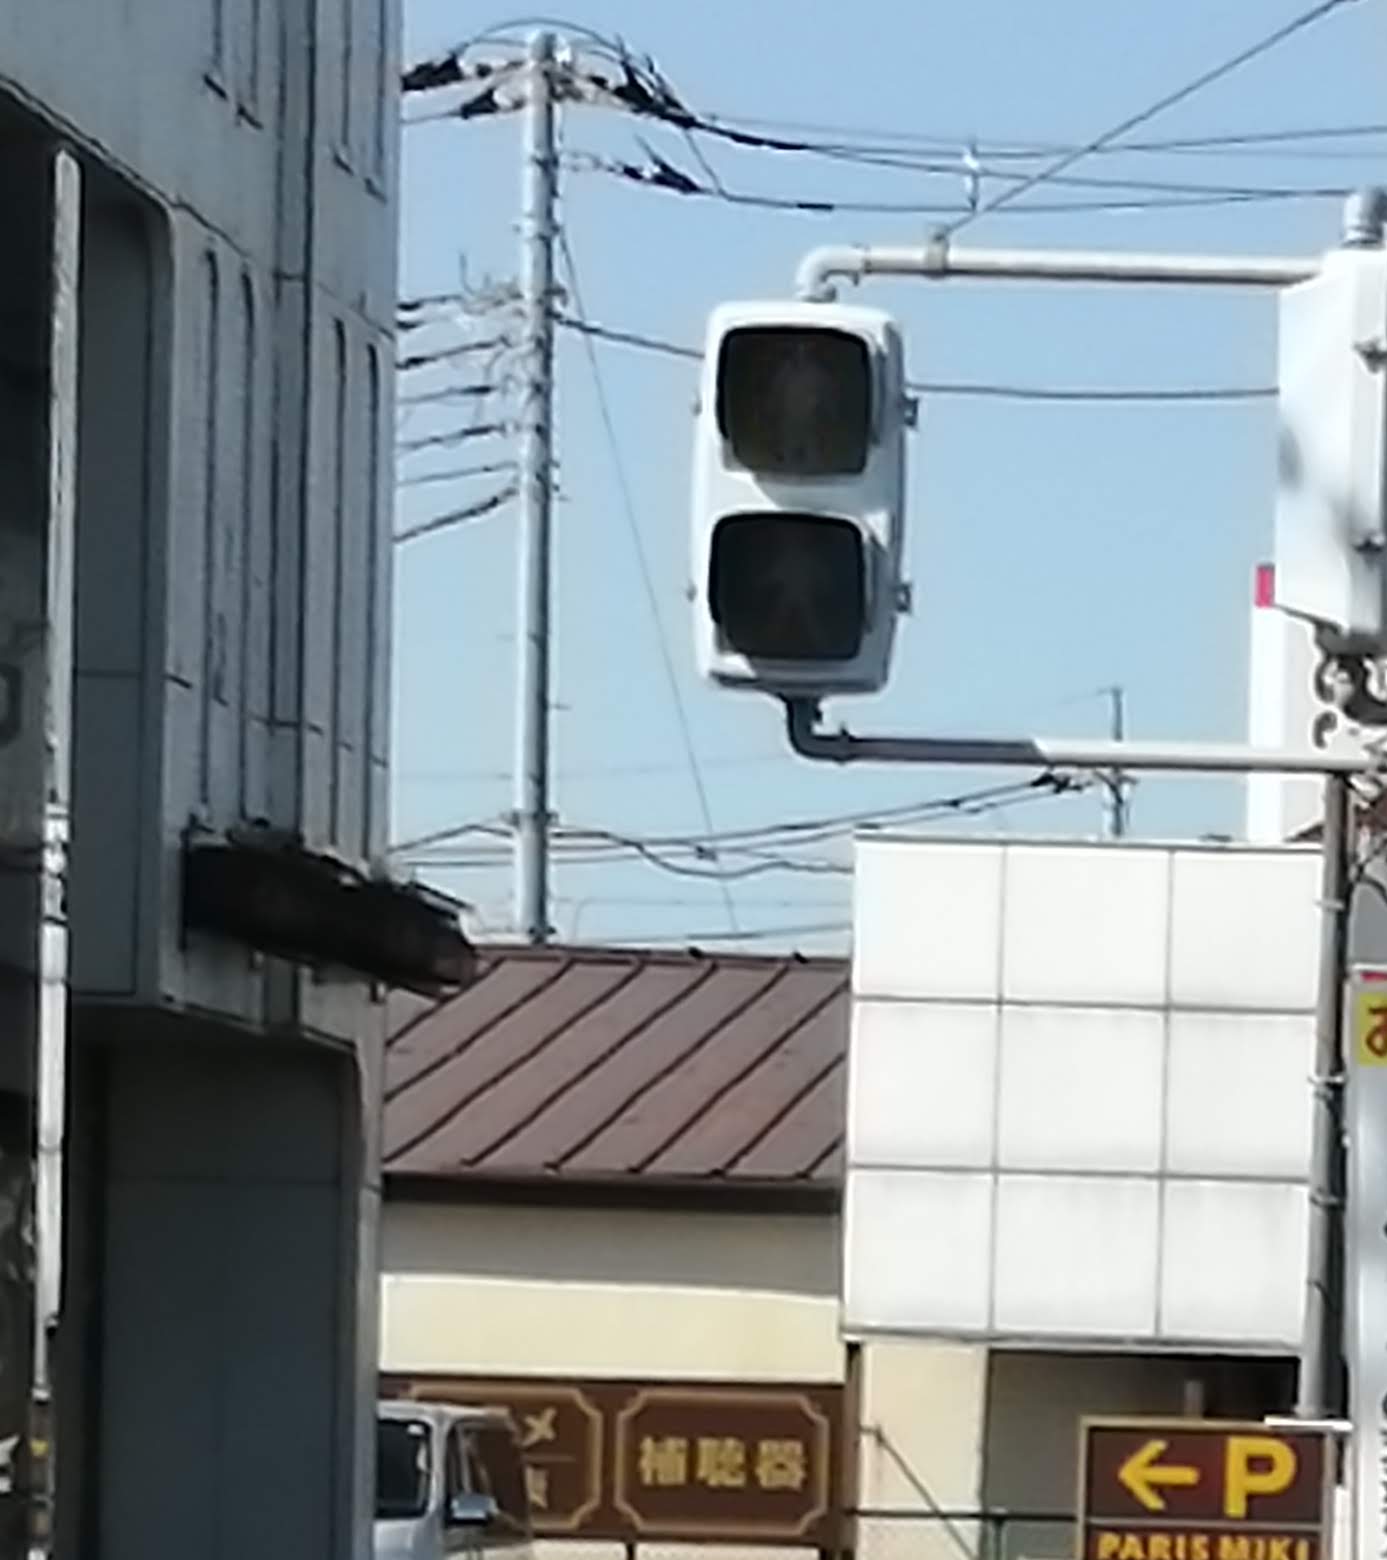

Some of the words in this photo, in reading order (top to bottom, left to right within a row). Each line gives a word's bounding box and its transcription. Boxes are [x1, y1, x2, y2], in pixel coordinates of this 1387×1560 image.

[639, 1437, 806, 1490] 補聴器
[1224, 1435, 1296, 1518] P
